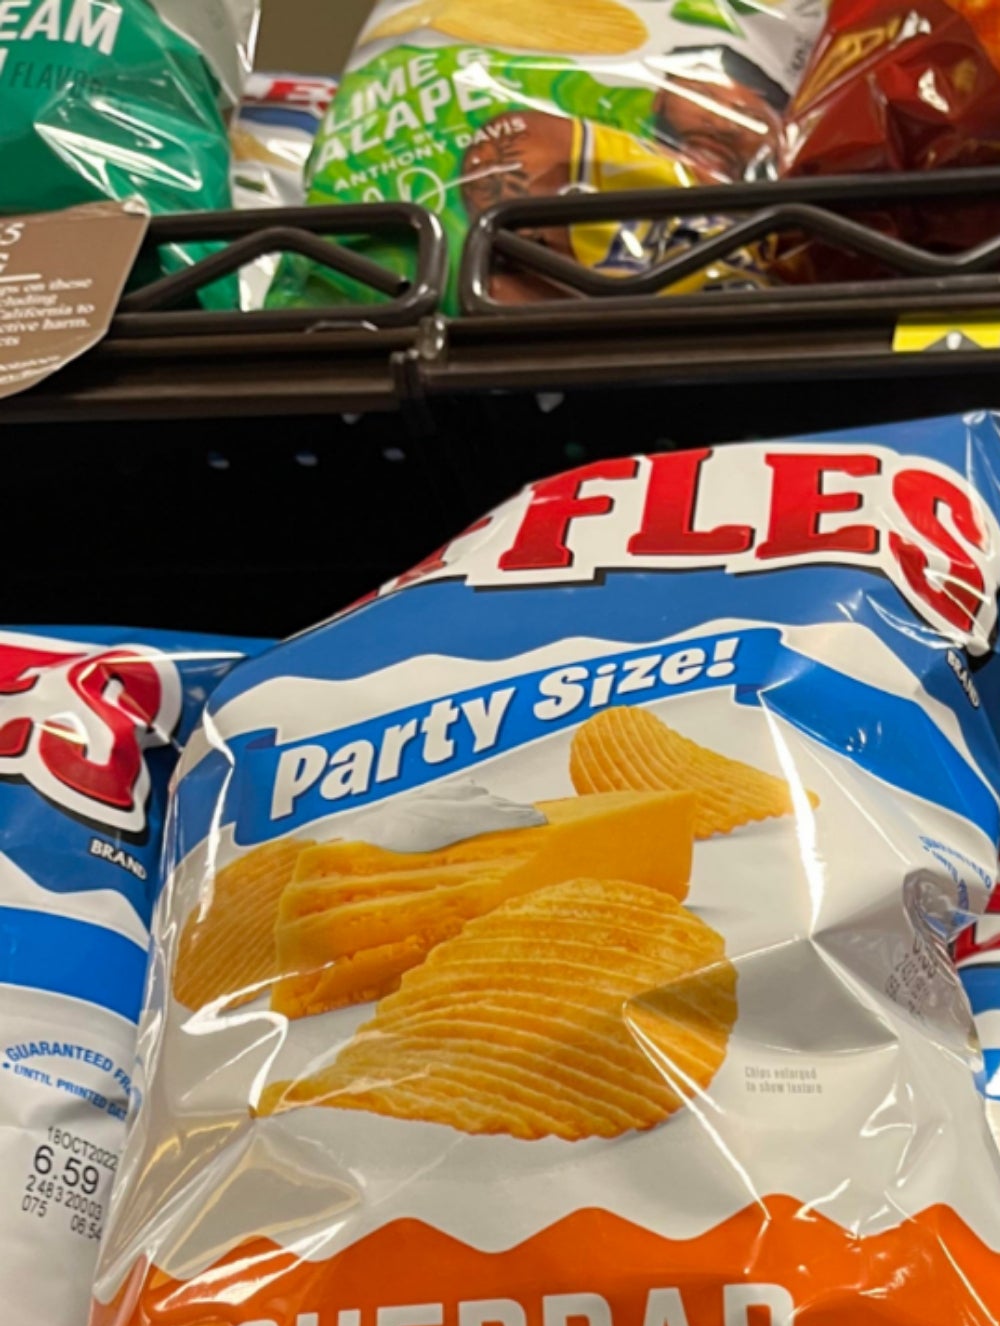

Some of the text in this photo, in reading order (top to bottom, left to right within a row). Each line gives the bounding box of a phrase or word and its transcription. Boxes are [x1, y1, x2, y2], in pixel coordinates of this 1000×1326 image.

[315, 76, 500, 173] ALAPE
[325, 53, 440, 135] LIME
[334, 116, 528, 193] ANTHONY DAVIS
[395, 447, 988, 633] FLES
[270, 636, 740, 822] Party Size!
[89, 838, 148, 882] BRAND
[5, 1040, 115, 1073] GUARANTEED
[14, 1064, 128, 1122] UNTIL PRINTED DAT
[34, 1145, 101, 1195] 6.59
[22, 1195, 48, 1218] 075
